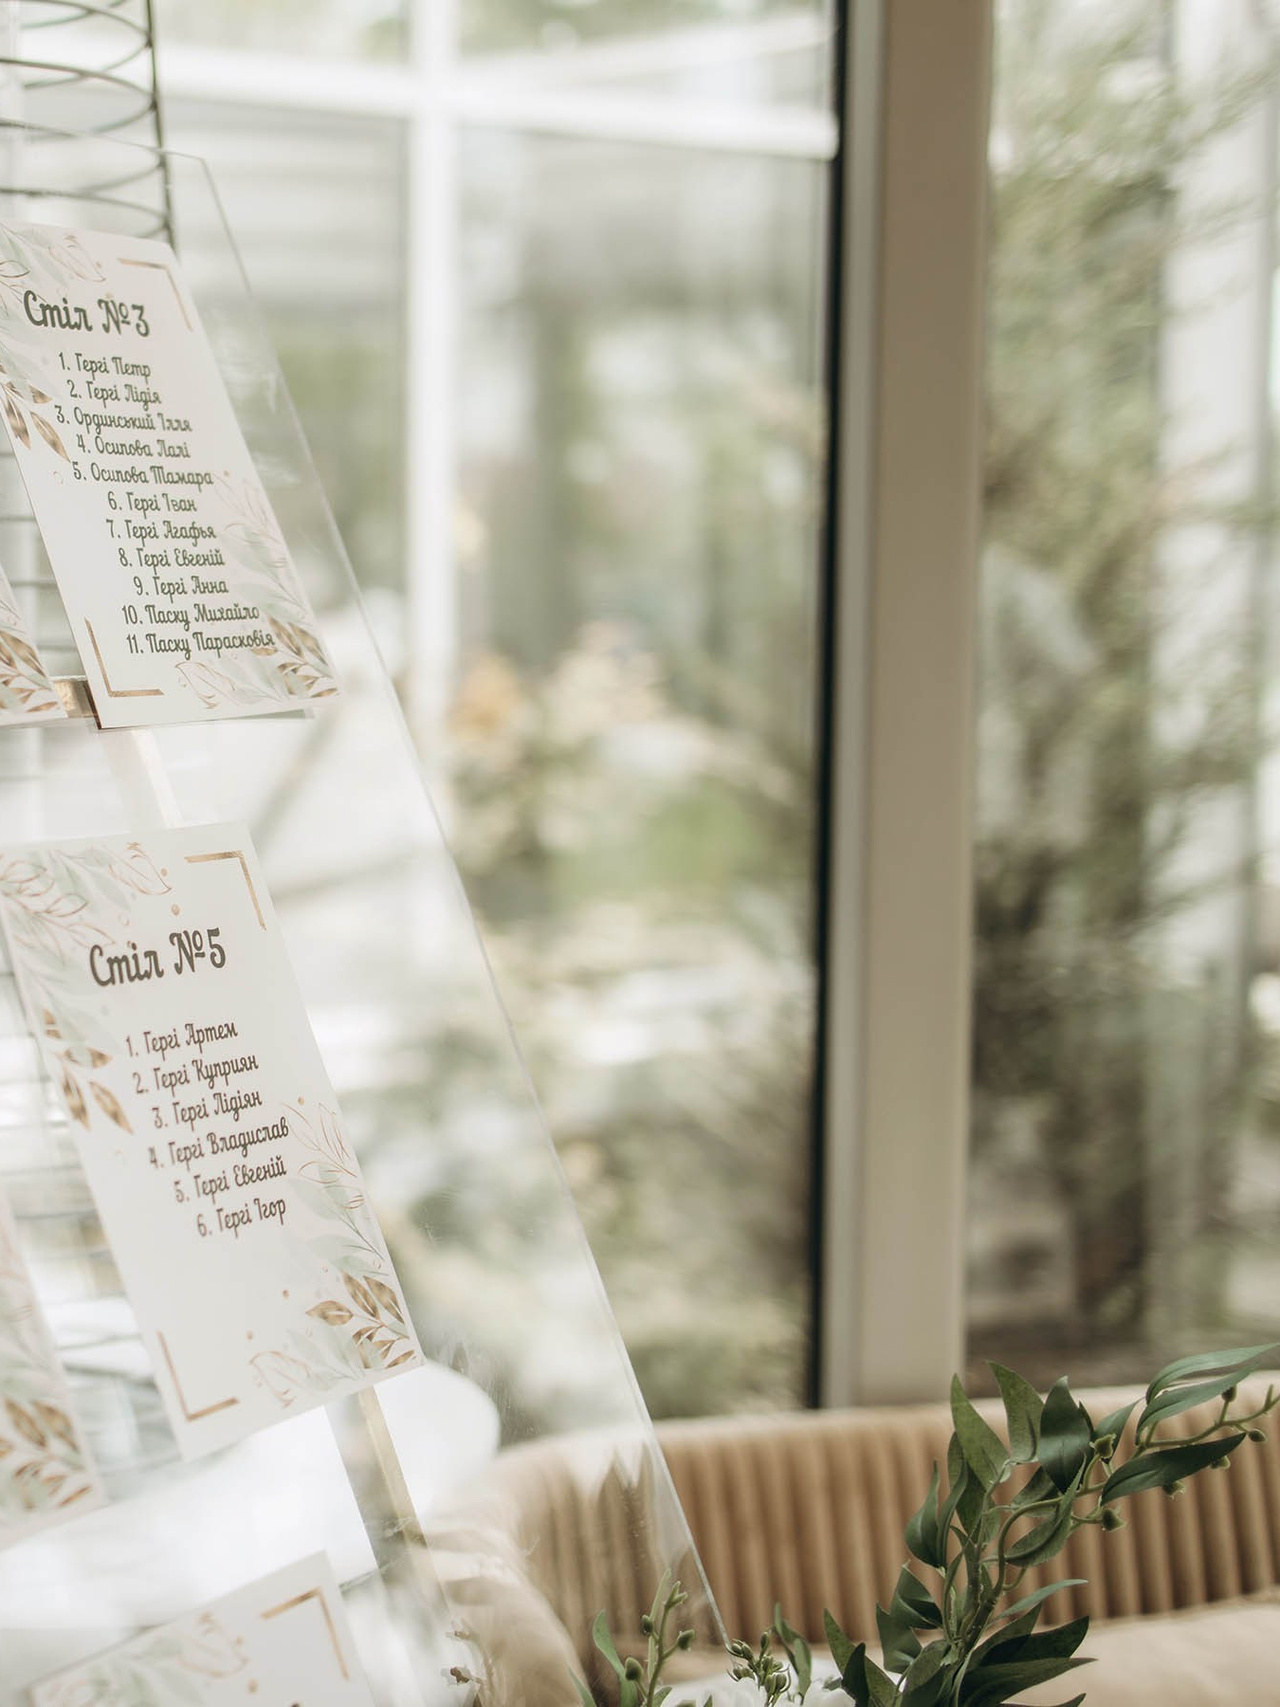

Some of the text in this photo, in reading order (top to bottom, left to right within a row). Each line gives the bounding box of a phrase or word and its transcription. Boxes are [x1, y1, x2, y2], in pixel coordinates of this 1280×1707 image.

[23, 290, 150, 337] Стіл №3
[59, 352, 151, 385] 1. Гергі Петр
[67, 379, 162, 412] 2. Гергі Лідія
[54, 405, 192, 435] 3. Ординський Ілля
[76, 434, 91, 454] 4.
[95, 435, 153, 458] Осипова
[72, 461, 214, 493] 5. Осипова Тамара
[107, 491, 197, 520] 6. Гергі Іван
[105, 519, 121, 539] 7.
[124, 520, 160, 548] Гергі
[118, 548, 133, 567] 8.
[136, 548, 171, 575] Гергі
[133, 576, 229, 603] 9. Гергі Анна
[122, 602, 260, 632] 10. Паску Михайло
[126, 628, 275, 660] 11. Паску Парасковія
[90, 927, 226, 986] Стіл №5
[126, 1020, 238, 1061] 1. Гергі Артем
[133, 1054, 259, 1097] 2. Гергі Куприян
[151, 1090, 262, 1131] 3. Гергі Лідіян
[148, 1116, 289, 1172] 4. Гергі Владислав
[174, 1181, 189, 1203] 5.
[193, 1171, 229, 1205] Гергі
[197, 1198, 286, 1238] 6. Гергі Ігор
